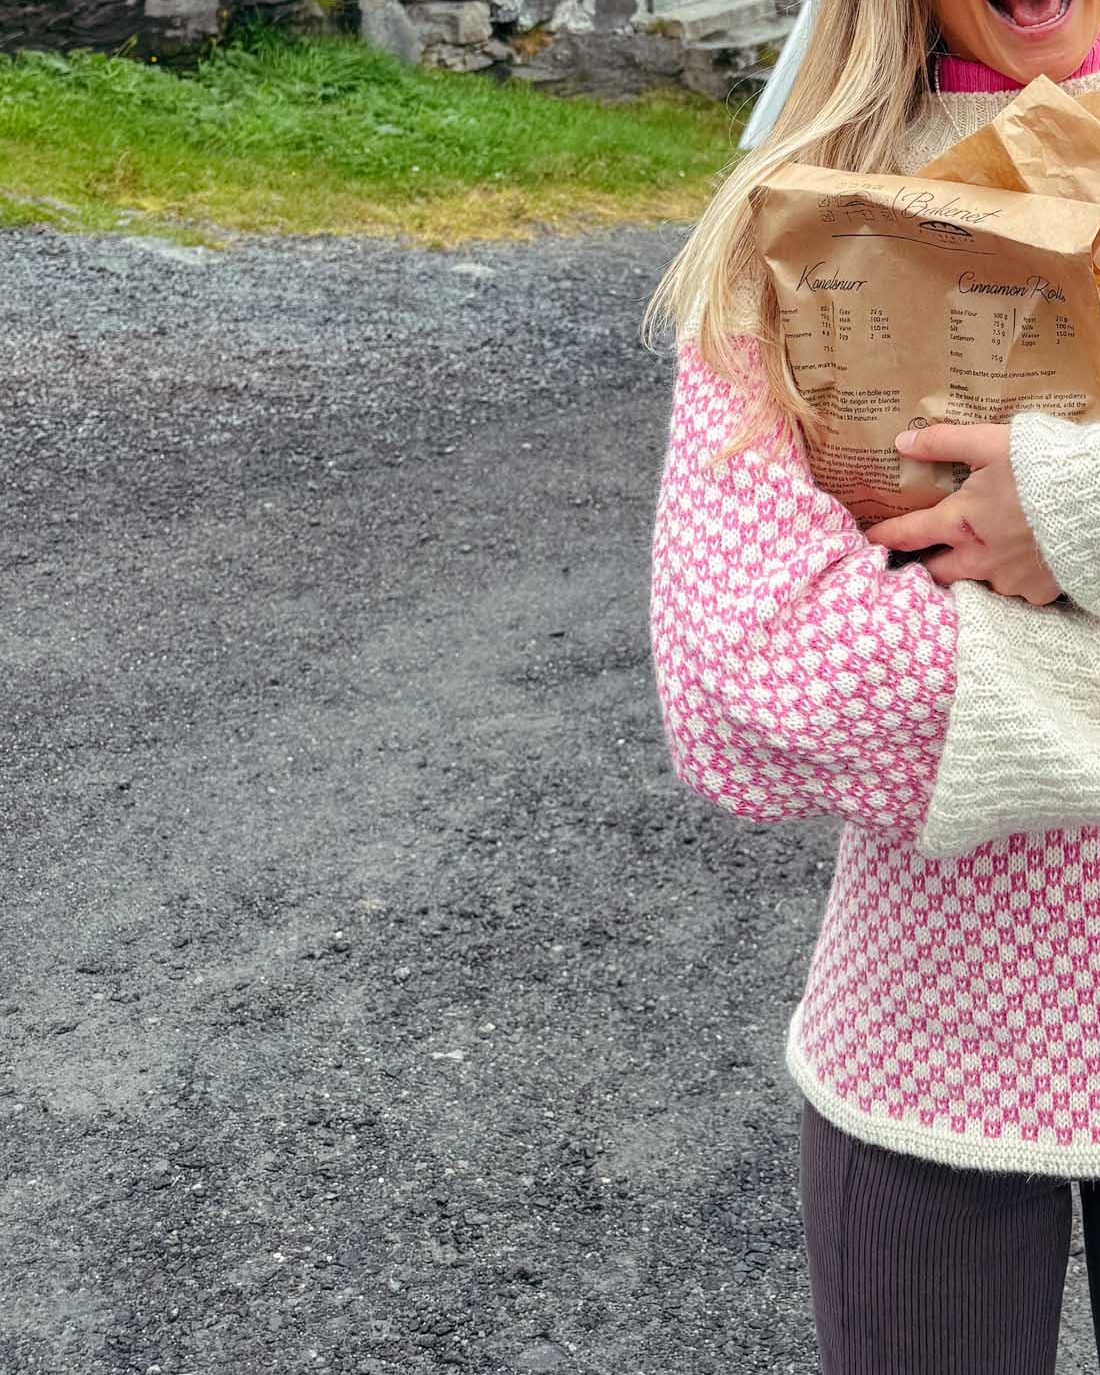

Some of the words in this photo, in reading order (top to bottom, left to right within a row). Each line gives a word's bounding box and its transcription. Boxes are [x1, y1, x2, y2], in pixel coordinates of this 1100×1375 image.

[902, 191, 1003, 224] Bakeriet
[796, 261, 868, 292] Kanelsnurr
[958, 271, 1028, 297] Cinnamon
